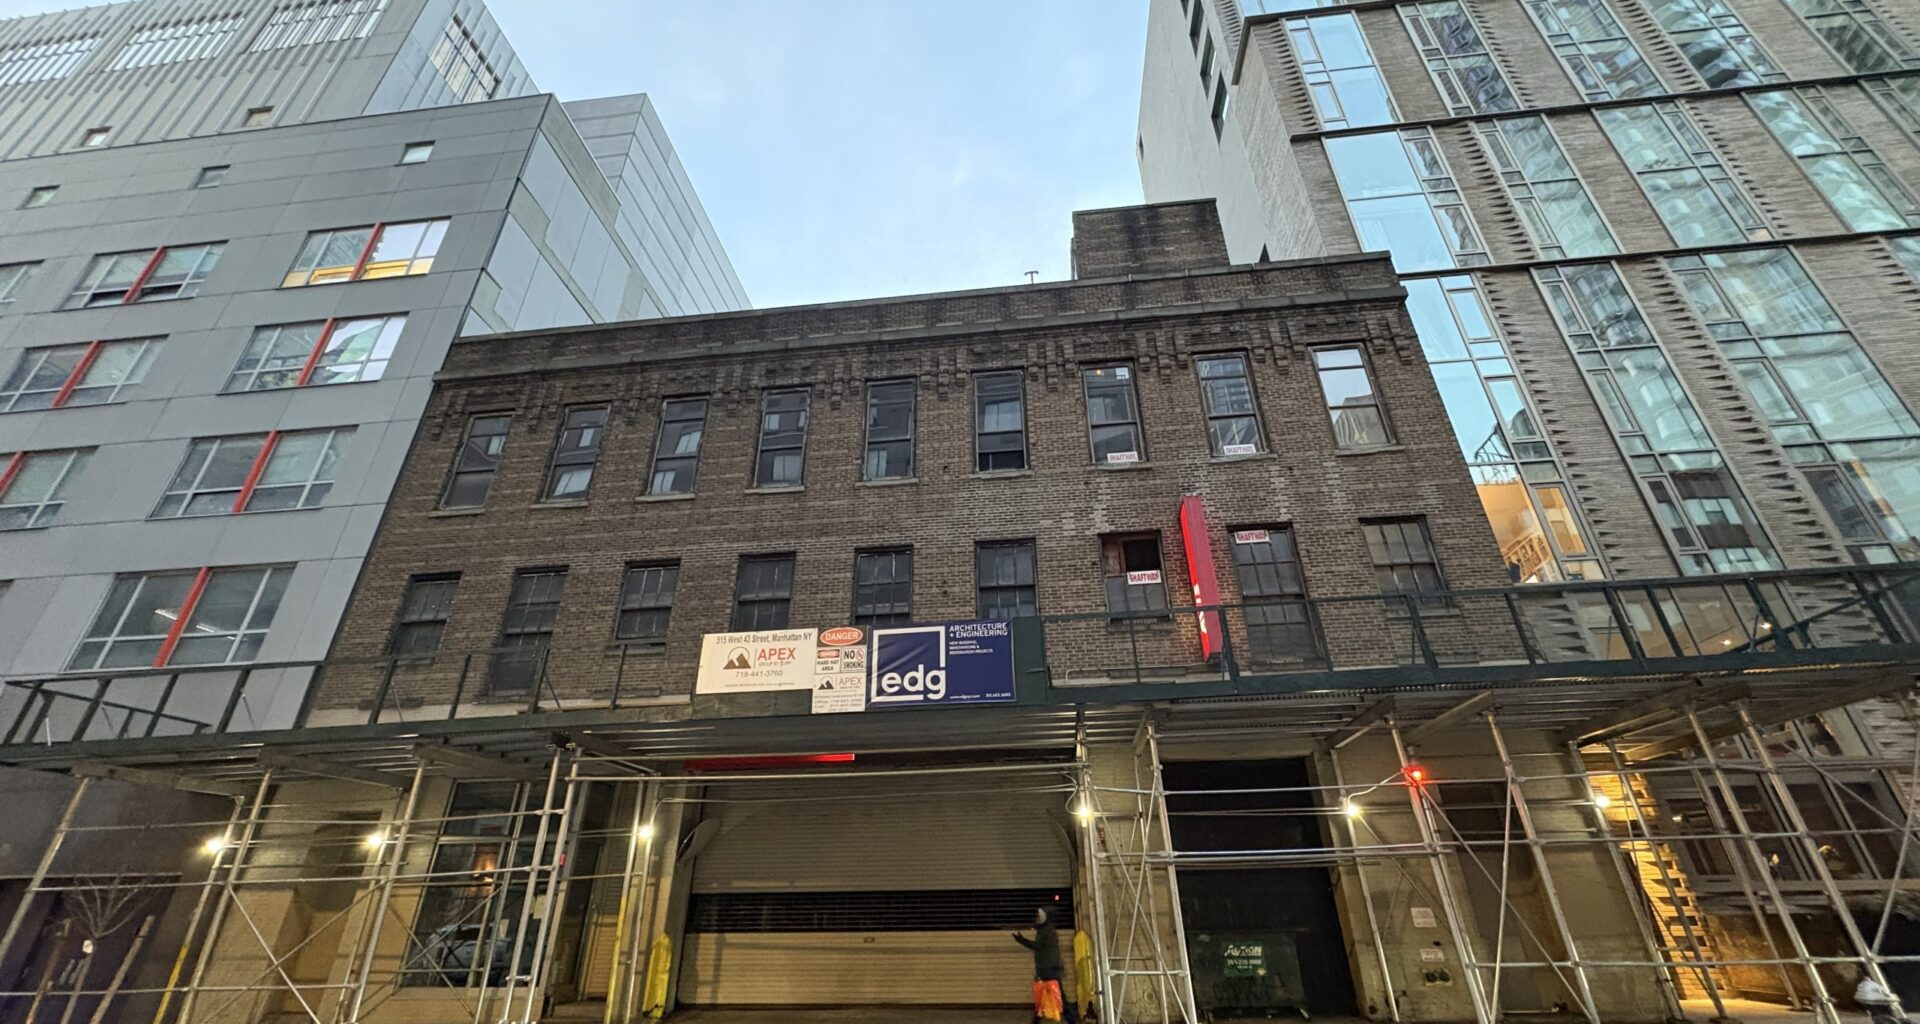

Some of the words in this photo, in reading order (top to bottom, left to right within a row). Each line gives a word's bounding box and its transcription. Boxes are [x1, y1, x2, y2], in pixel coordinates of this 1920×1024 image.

[1109, 453, 1137, 462] SHAFTWAY
[1236, 531, 1268, 541] SHAFTWAY
[1129, 572, 1160, 582] SHAFTWAY
[949, 622, 1008, 632] ARCHITECTURE
[716, 636, 727, 644] 515
[728, 635, 742, 644] West
[743, 635, 751, 643] 43
[752, 634, 771, 644] Street,
[772, 633, 802, 642] Manhattan
[803, 632, 813, 640] NY
[825, 632, 859, 641] DANGER
[956, 629, 1008, 638] ENGINEERING
[757, 647, 796, 660] APEX
[844, 650, 856, 660] NO
[843, 661, 864, 669] SMOKING
[839, 677, 863, 685] APEX
[881, 664, 946, 700] edg
